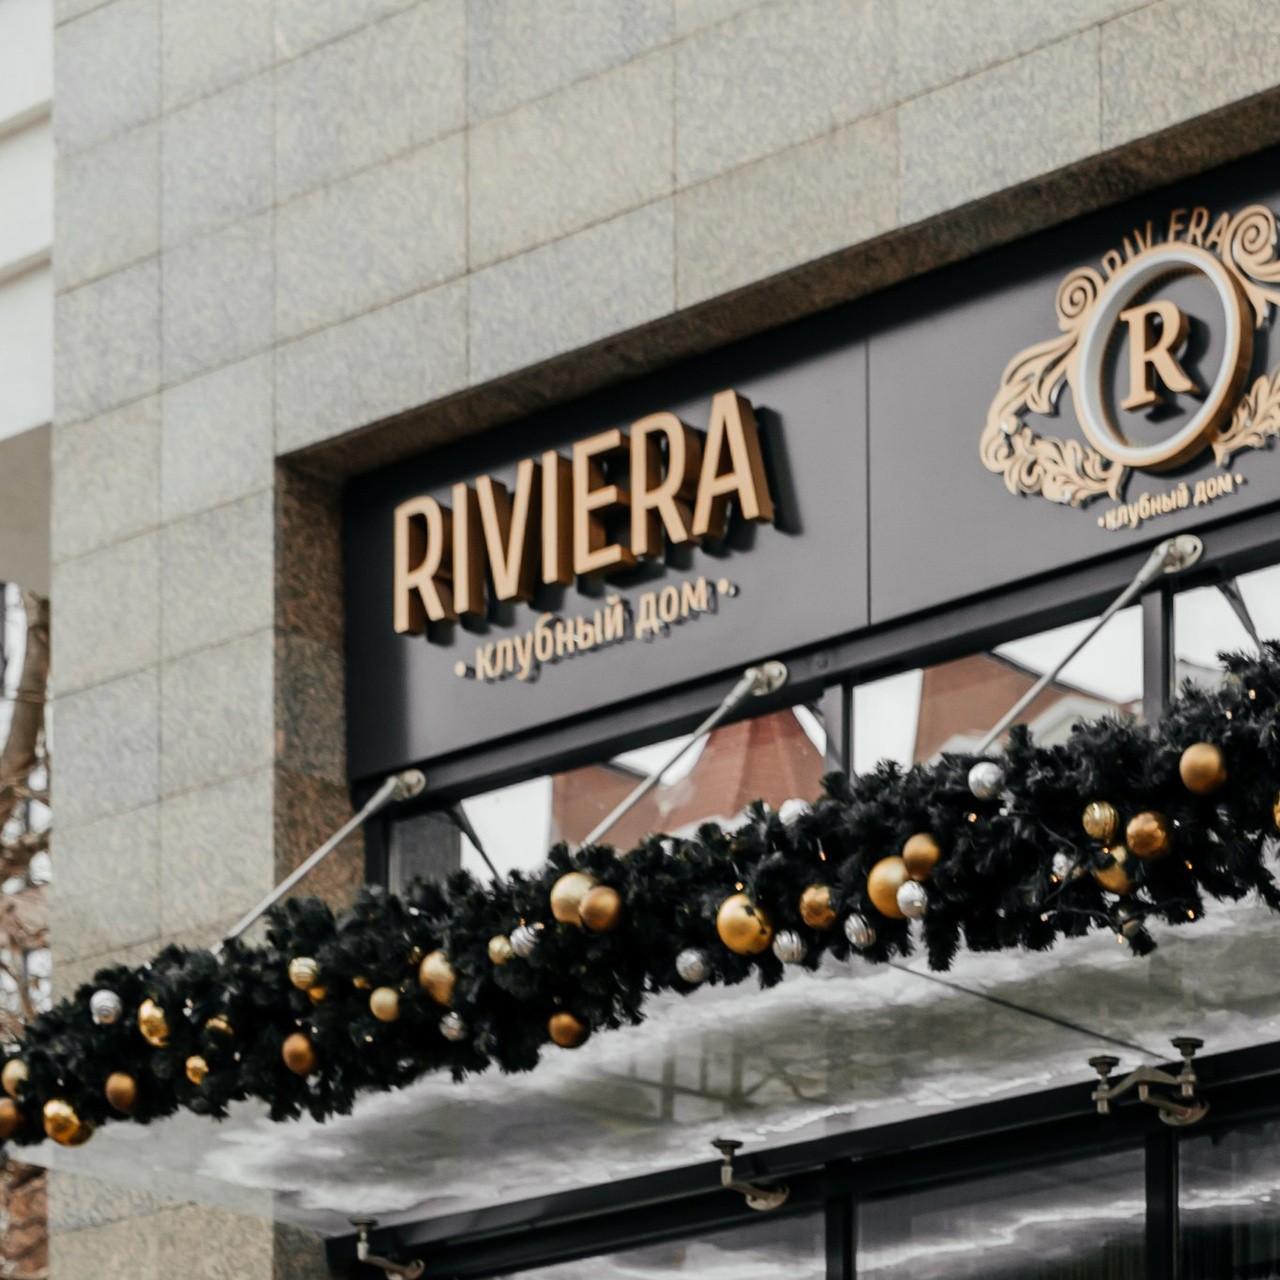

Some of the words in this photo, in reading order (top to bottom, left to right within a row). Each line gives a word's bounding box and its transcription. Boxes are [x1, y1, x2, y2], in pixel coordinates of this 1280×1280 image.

[1118, 299, 1198, 413] R
[394, 389, 773, 634] RIVIERA
[1105, 482, 1190, 530] клубный
[1193, 472, 1234, 507] дом
[475, 594, 625, 680] клубный
[634, 576, 710, 640] дом
